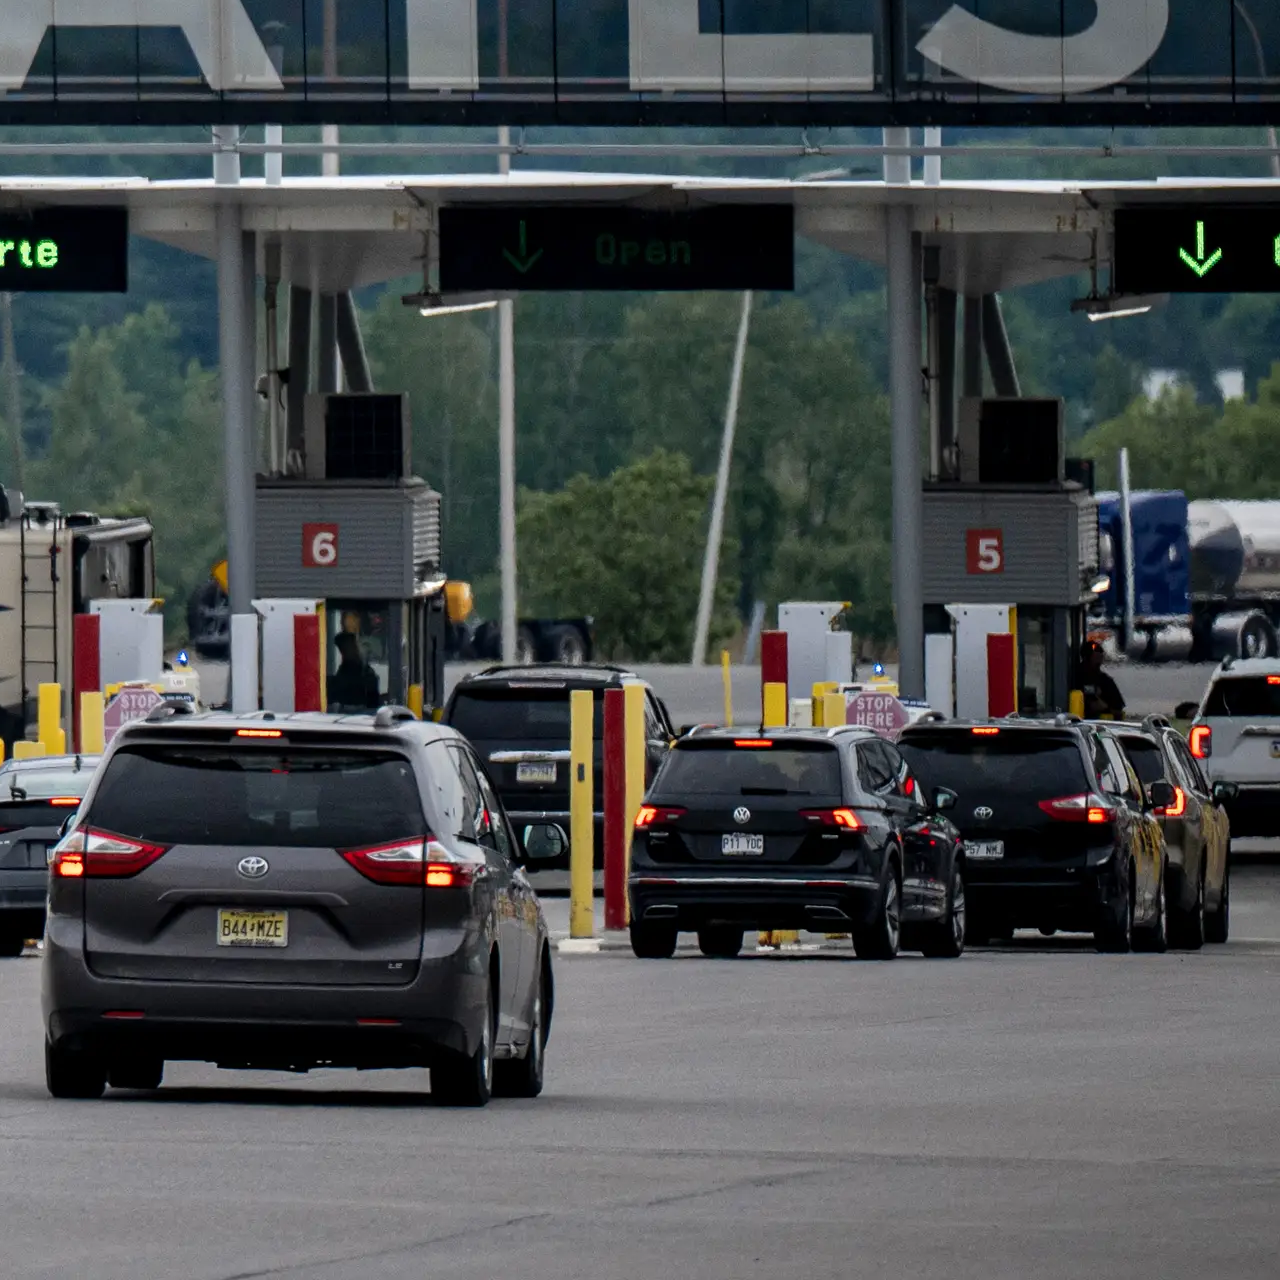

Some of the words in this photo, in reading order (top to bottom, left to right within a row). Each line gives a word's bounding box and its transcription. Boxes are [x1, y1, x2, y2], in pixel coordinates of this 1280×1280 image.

[595, 232, 690, 264] Open
[312, 531, 336, 565] 6
[977, 538, 1001, 571] 5
[120, 695, 156, 708] STOP
[857, 697, 893, 710] STOP
[856, 712, 894, 726] HERE
[723, 837, 739, 849] P11
[222, 919, 248, 938] B44
[256, 921, 282, 938] MZE
